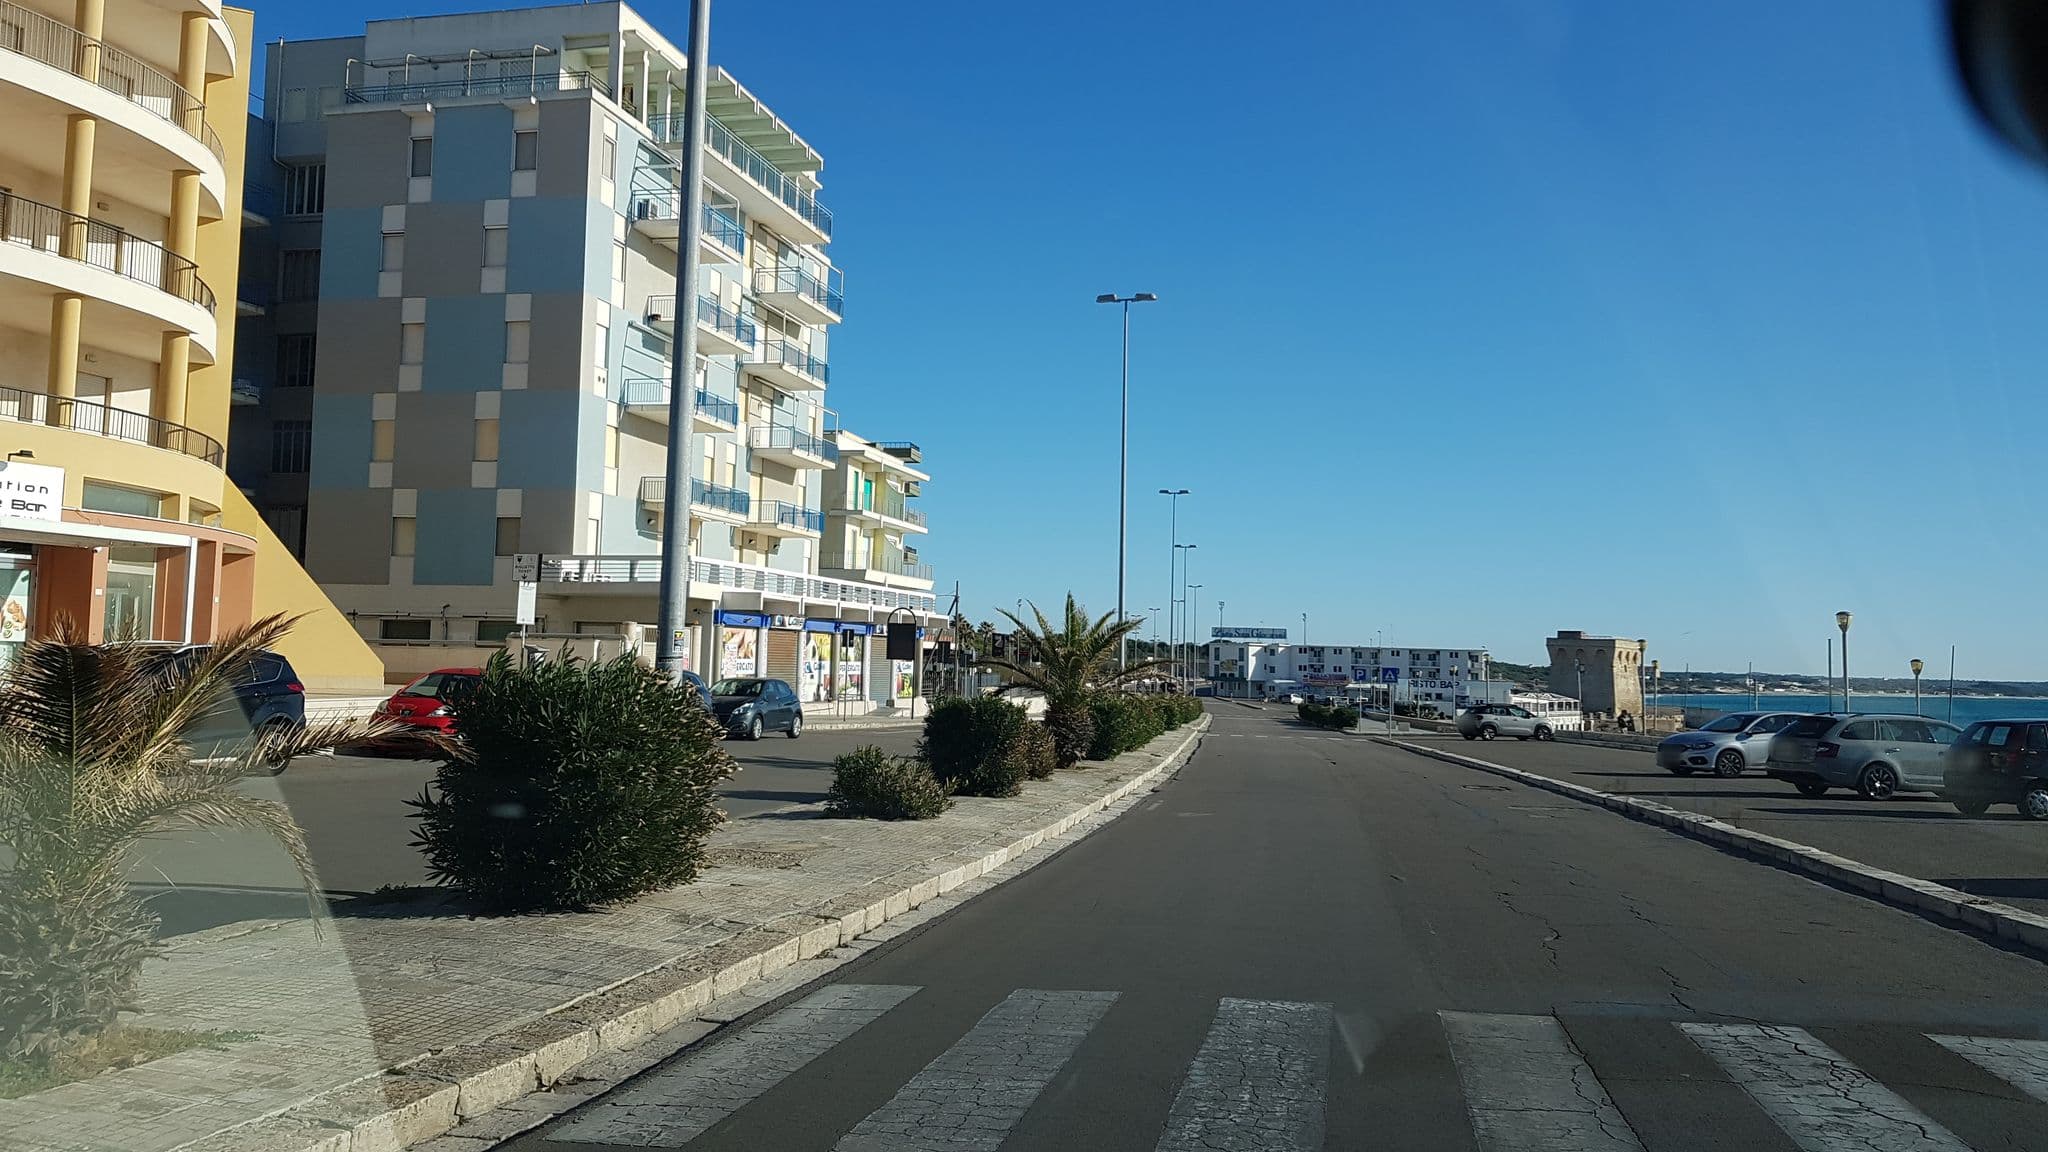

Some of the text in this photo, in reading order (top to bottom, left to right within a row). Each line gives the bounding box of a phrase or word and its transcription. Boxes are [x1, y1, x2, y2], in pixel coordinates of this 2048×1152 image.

[0, 481, 48, 494] tion
[11, 499, 47, 512] Bar
[1357, 670, 1364, 679] P
